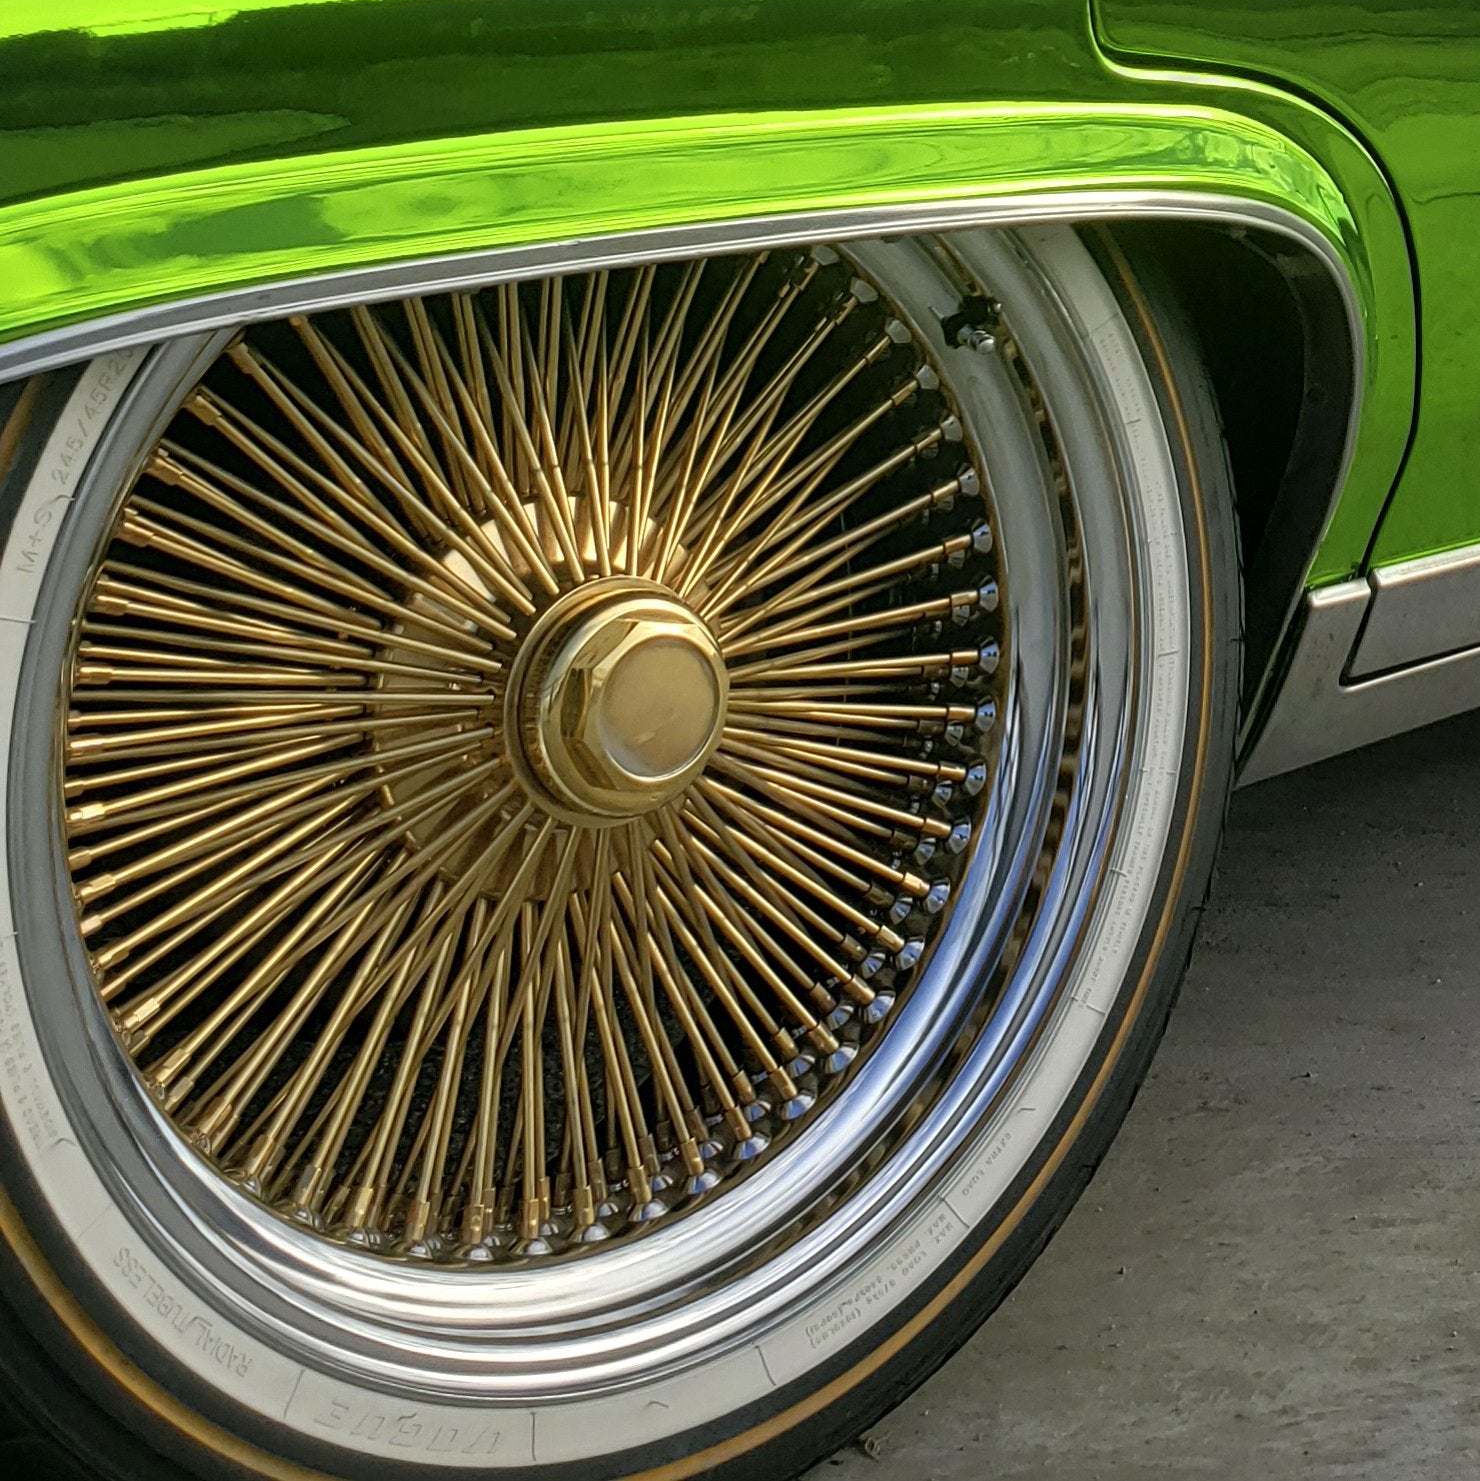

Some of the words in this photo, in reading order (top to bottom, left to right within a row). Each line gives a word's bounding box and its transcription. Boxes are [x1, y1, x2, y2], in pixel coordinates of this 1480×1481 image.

[16, 503, 53, 573] M+S
[113, 1247, 190, 1334] TUBELESS
[195, 1324, 253, 1378] RADIAL
[313, 1400, 502, 1454] VOGUE
